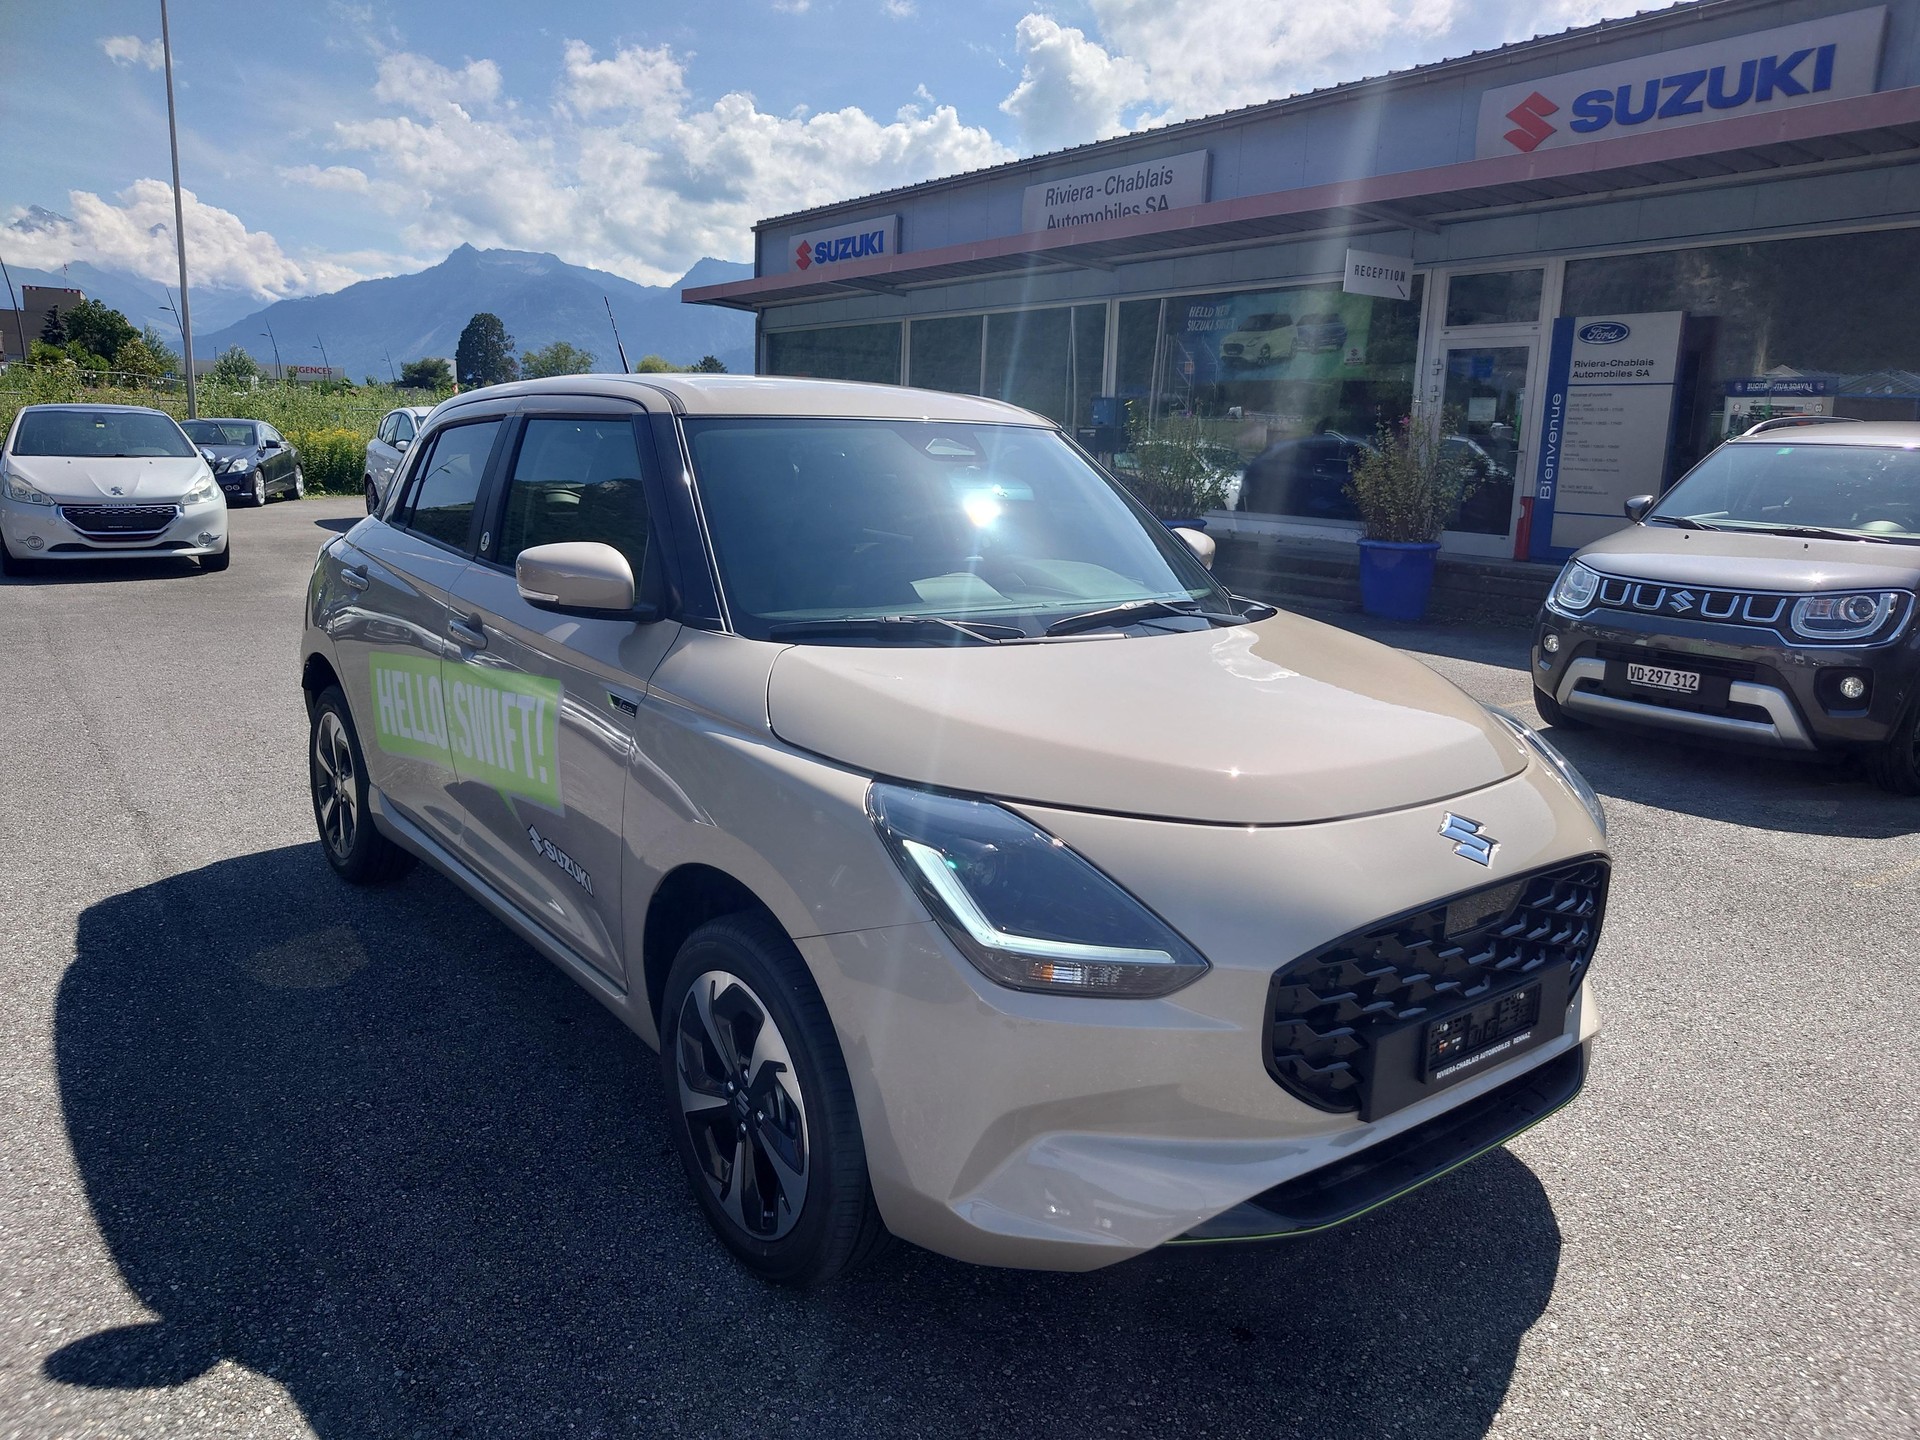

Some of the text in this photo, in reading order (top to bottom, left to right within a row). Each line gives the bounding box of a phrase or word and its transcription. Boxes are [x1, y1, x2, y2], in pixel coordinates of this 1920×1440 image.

[1570, 43, 1837, 133] SUZUKI
[1145, 194, 1170, 214] SA
[814, 230, 884, 265] SUZUKI
[1354, 264, 1406, 282] RECEPTION
[1189, 305, 1214, 318] HELLO
[1186, 319, 1214, 331] SUZUKI
[286, 366, 333, 375] GENCES
[1574, 359, 1655, 368] Riviera-Chablais
[1572, 369, 1650, 379] Automobiles SA
[1540, 393, 1562, 499] Bienvenue
[376, 668, 548, 784] HELLO SWIFT!
[543, 838, 595, 897] SUZUKI
[1479, 1040, 1511, 1060] AUTOMOBILES
